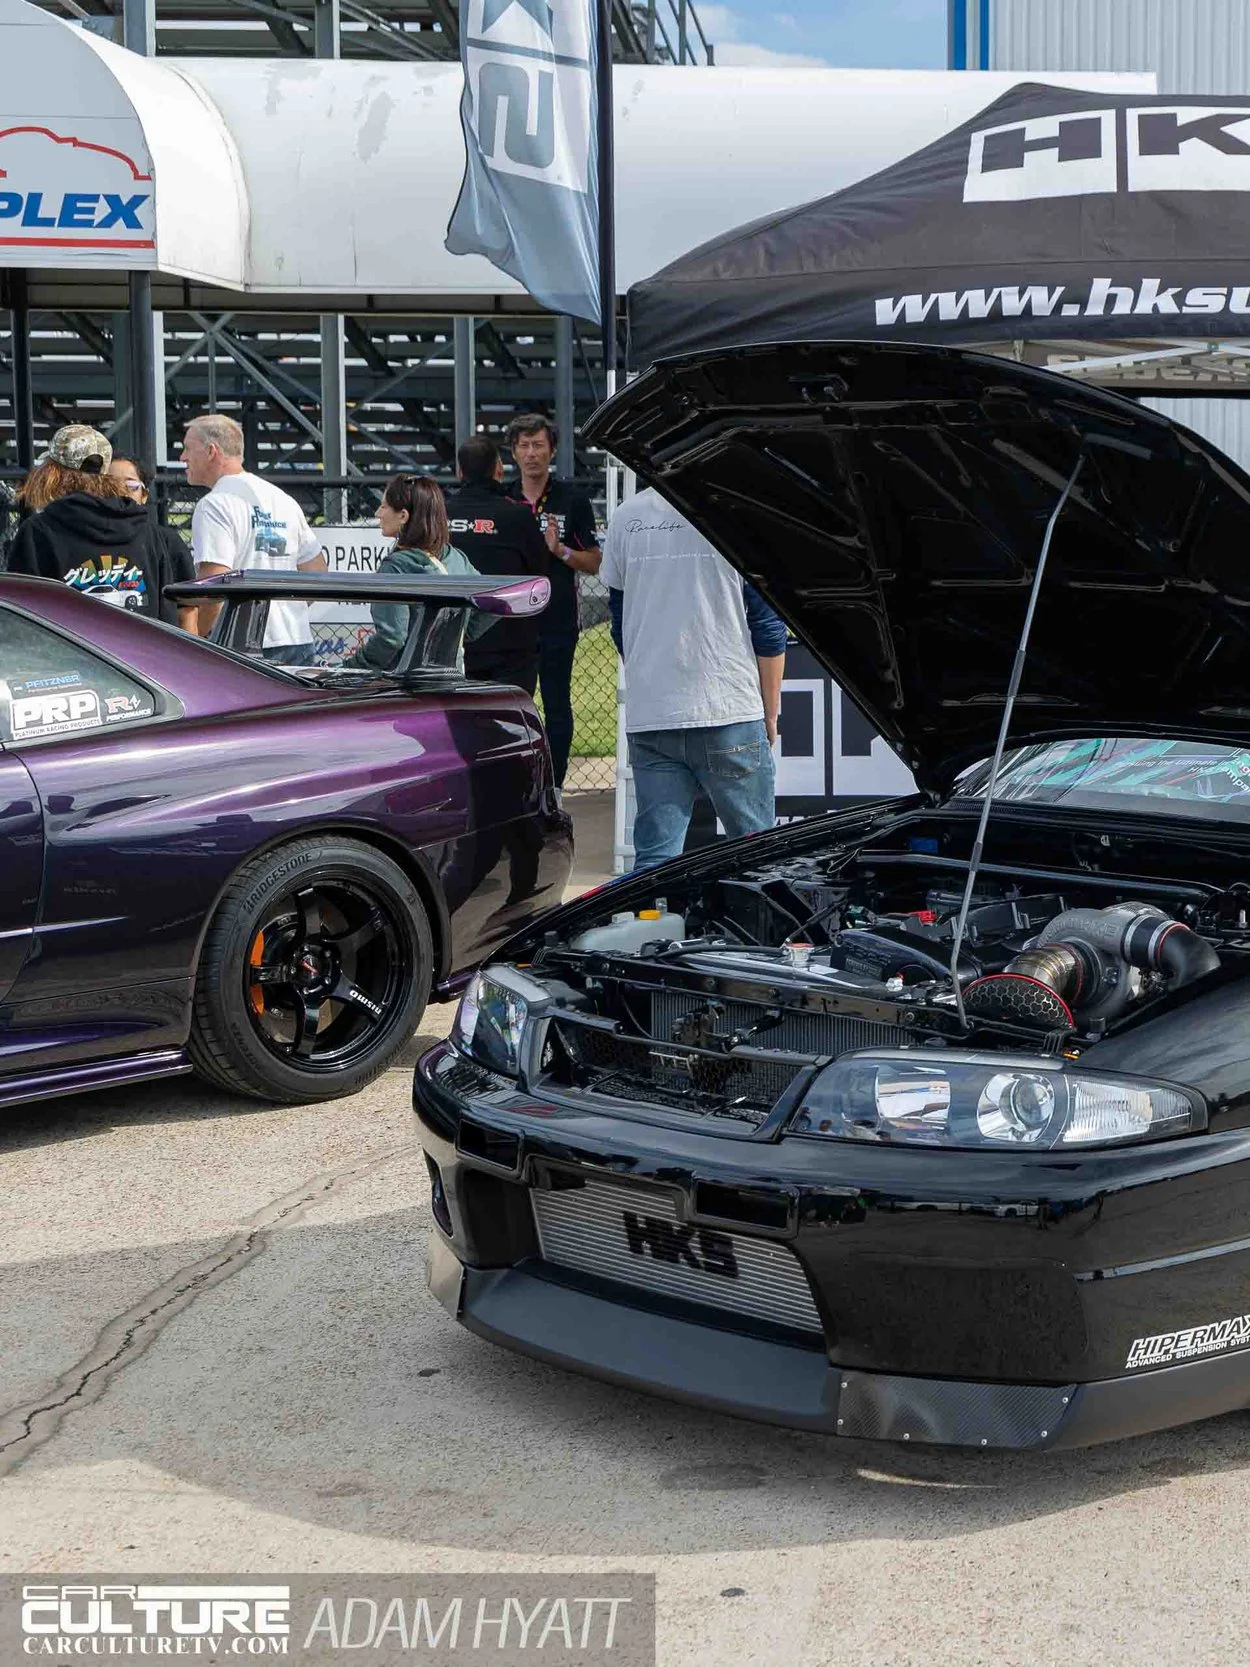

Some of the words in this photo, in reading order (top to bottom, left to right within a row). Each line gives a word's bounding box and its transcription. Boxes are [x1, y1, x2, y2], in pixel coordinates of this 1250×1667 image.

[13, 693, 97, 729] PRP
[242, 850, 313, 914] BRIDGESTONE
[622, 1210, 739, 1279] HKS
[1125, 1353, 1173, 1369] ADVANCED
[1175, 1341, 1228, 1360] SUSPENSION
